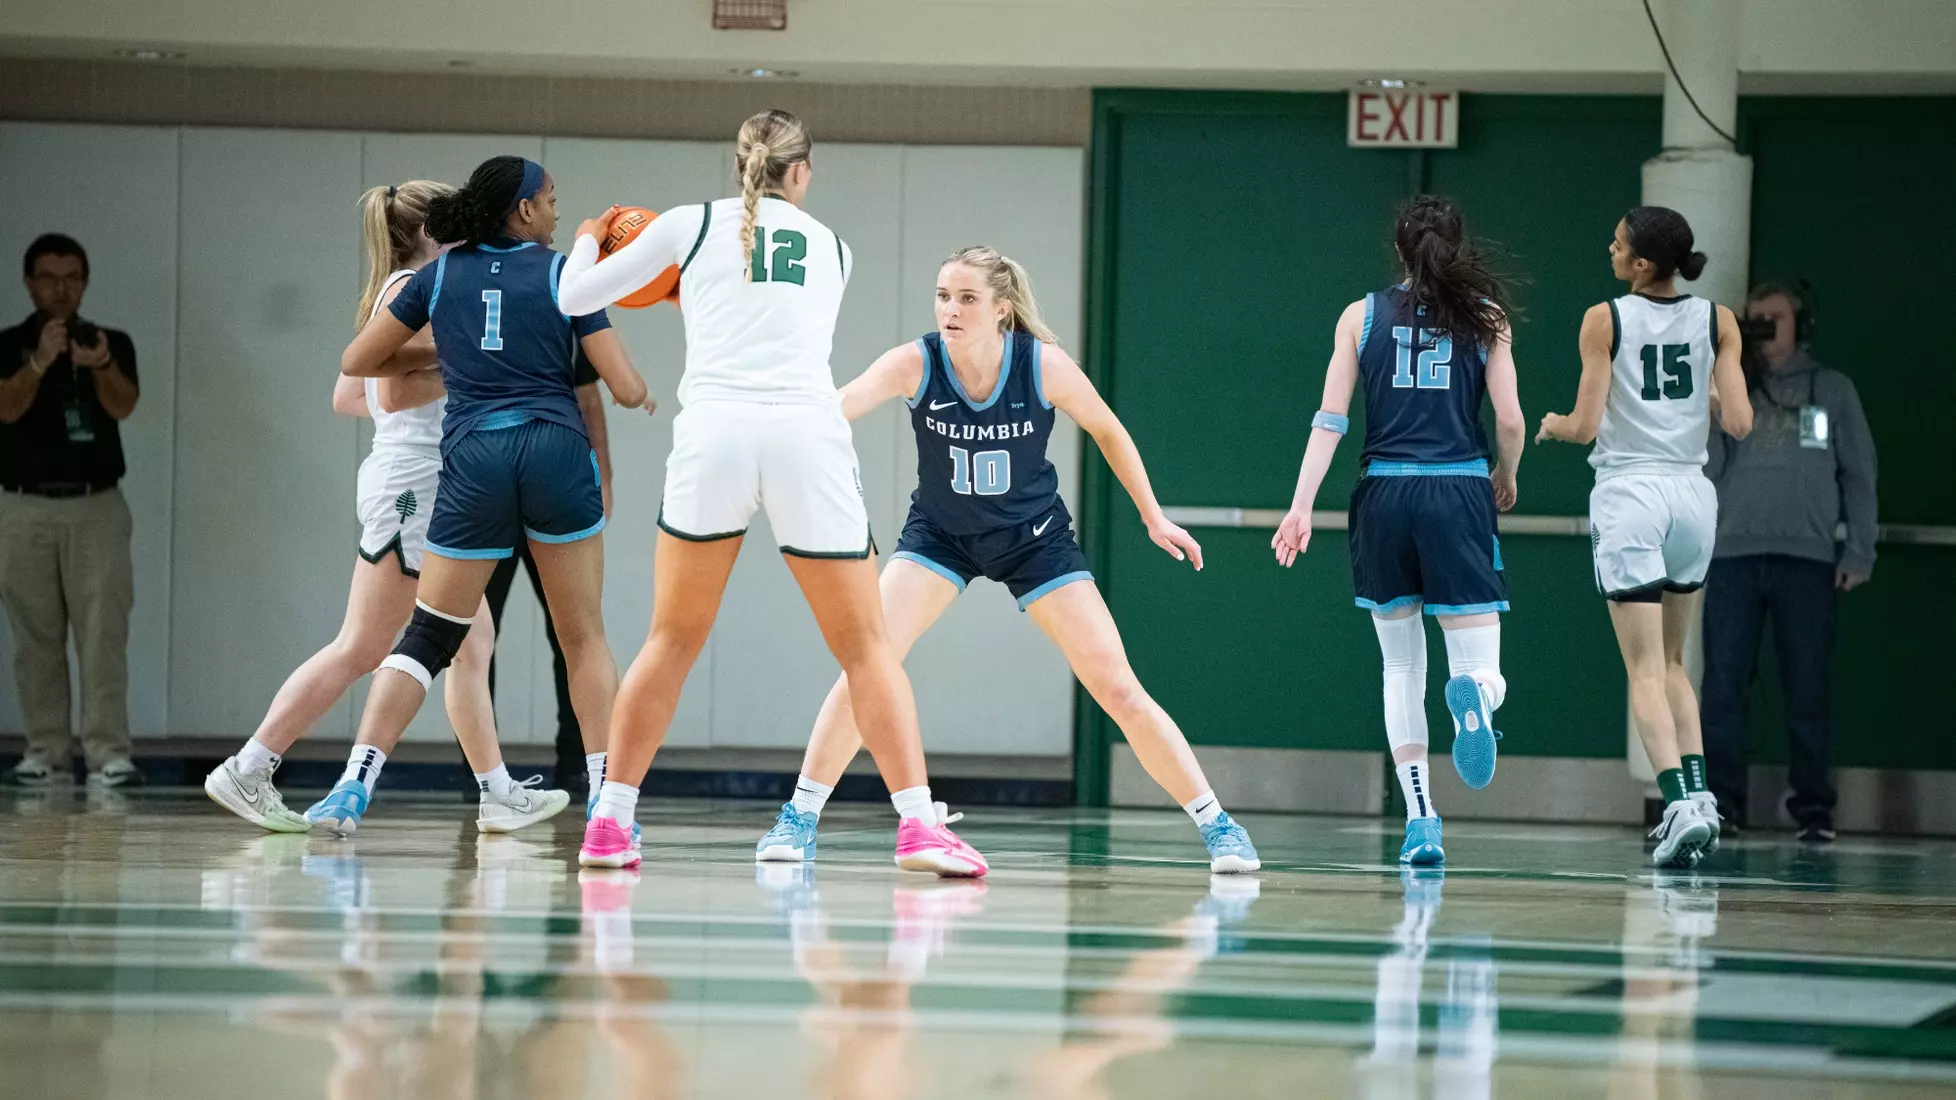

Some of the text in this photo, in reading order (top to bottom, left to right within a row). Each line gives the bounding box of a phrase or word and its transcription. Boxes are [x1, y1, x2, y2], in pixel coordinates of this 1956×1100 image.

[1357, 93, 1450, 141] EXIT
[490, 261, 501, 274] C
[744, 226, 807, 286] 12
[481, 290, 503, 350] 1
[1392, 326, 1453, 389] 12
[1640, 342, 1694, 400] 15
[925, 415, 1035, 441] COLUMBIA
[949, 444, 1011, 496] 10
